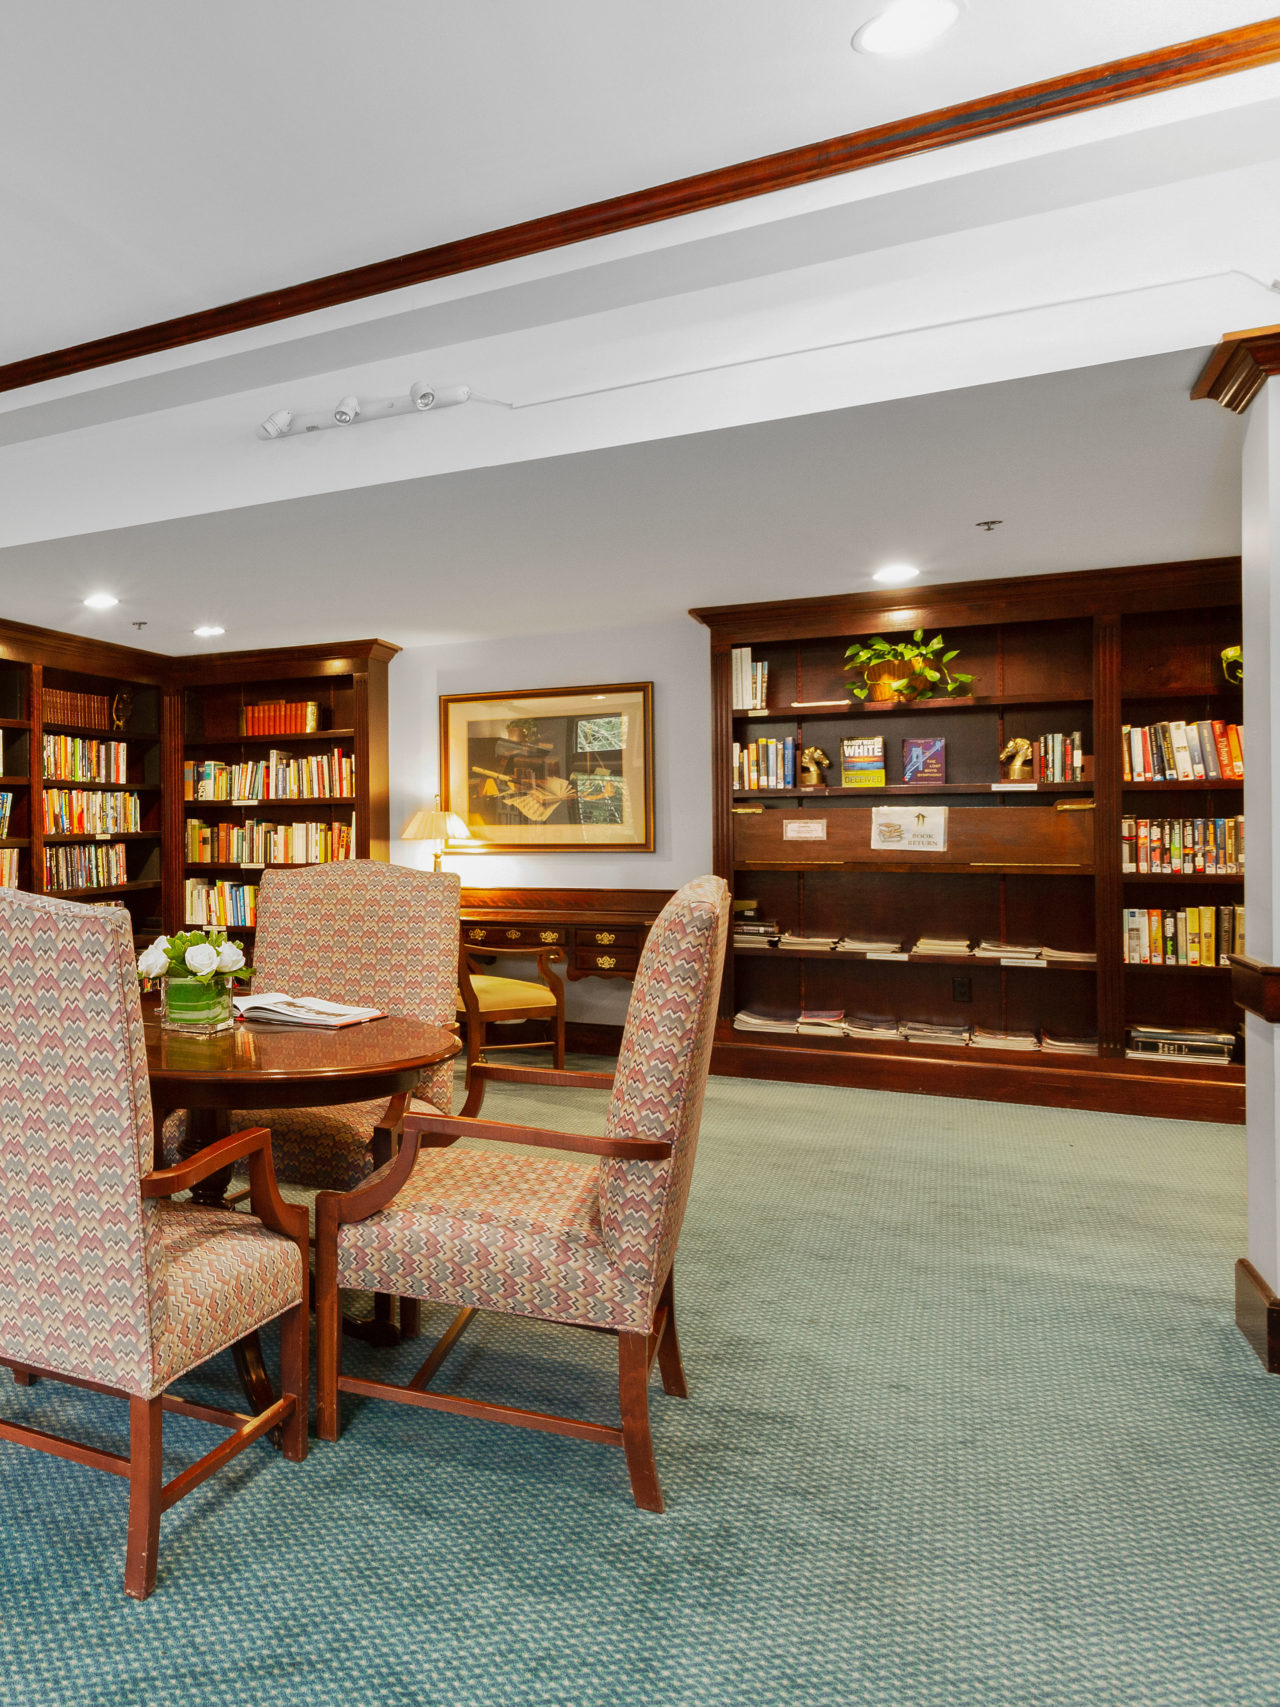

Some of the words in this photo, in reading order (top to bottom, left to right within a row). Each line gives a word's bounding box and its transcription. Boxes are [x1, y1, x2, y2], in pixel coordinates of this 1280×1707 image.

[844, 745, 882, 757] WHITE
[1218, 737, 1230, 765] Flyboys
[844, 776, 882, 784] DECEIVED
